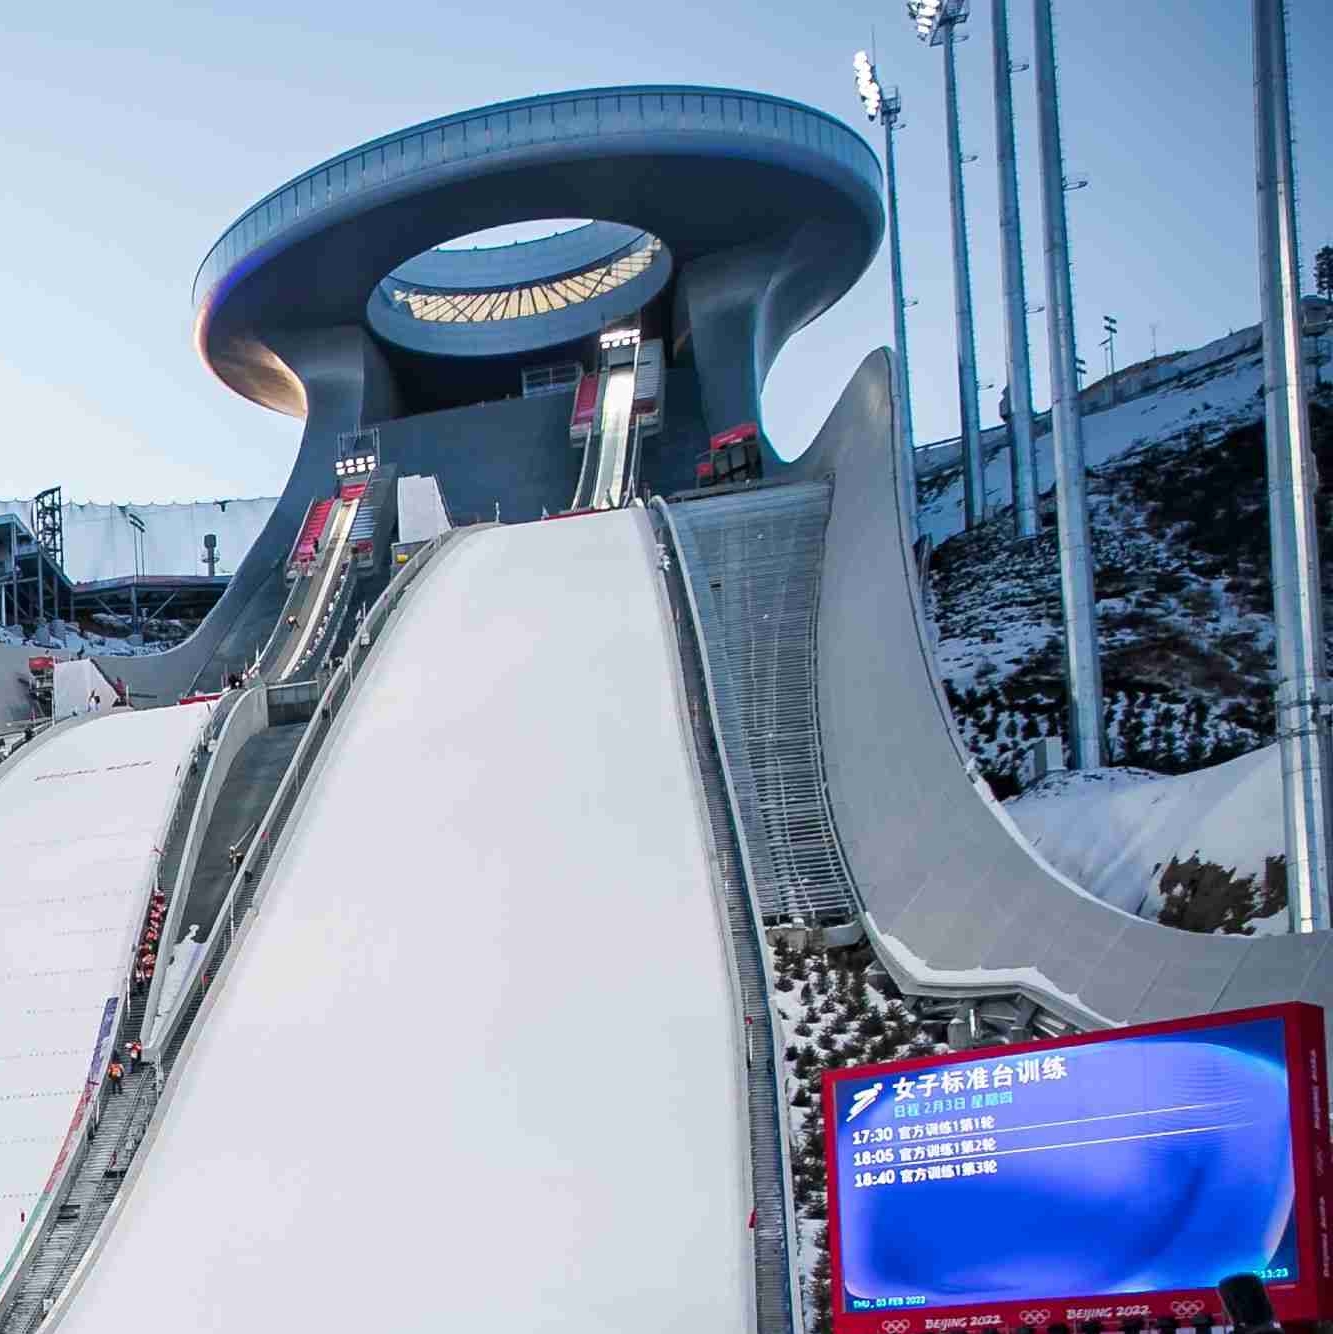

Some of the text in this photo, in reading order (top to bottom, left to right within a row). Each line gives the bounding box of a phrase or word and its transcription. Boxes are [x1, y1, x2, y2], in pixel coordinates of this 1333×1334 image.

[892, 1055, 1068, 1101] 女子标准台训练
[852, 1127, 894, 1145] 17:30
[853, 1148, 894, 1166] 18:05
[853, 1170, 896, 1188] 18:40
[1066, 1304, 1151, 1321] BEIJING 2022
[925, 1314, 1004, 1331] BEIJING 2022
